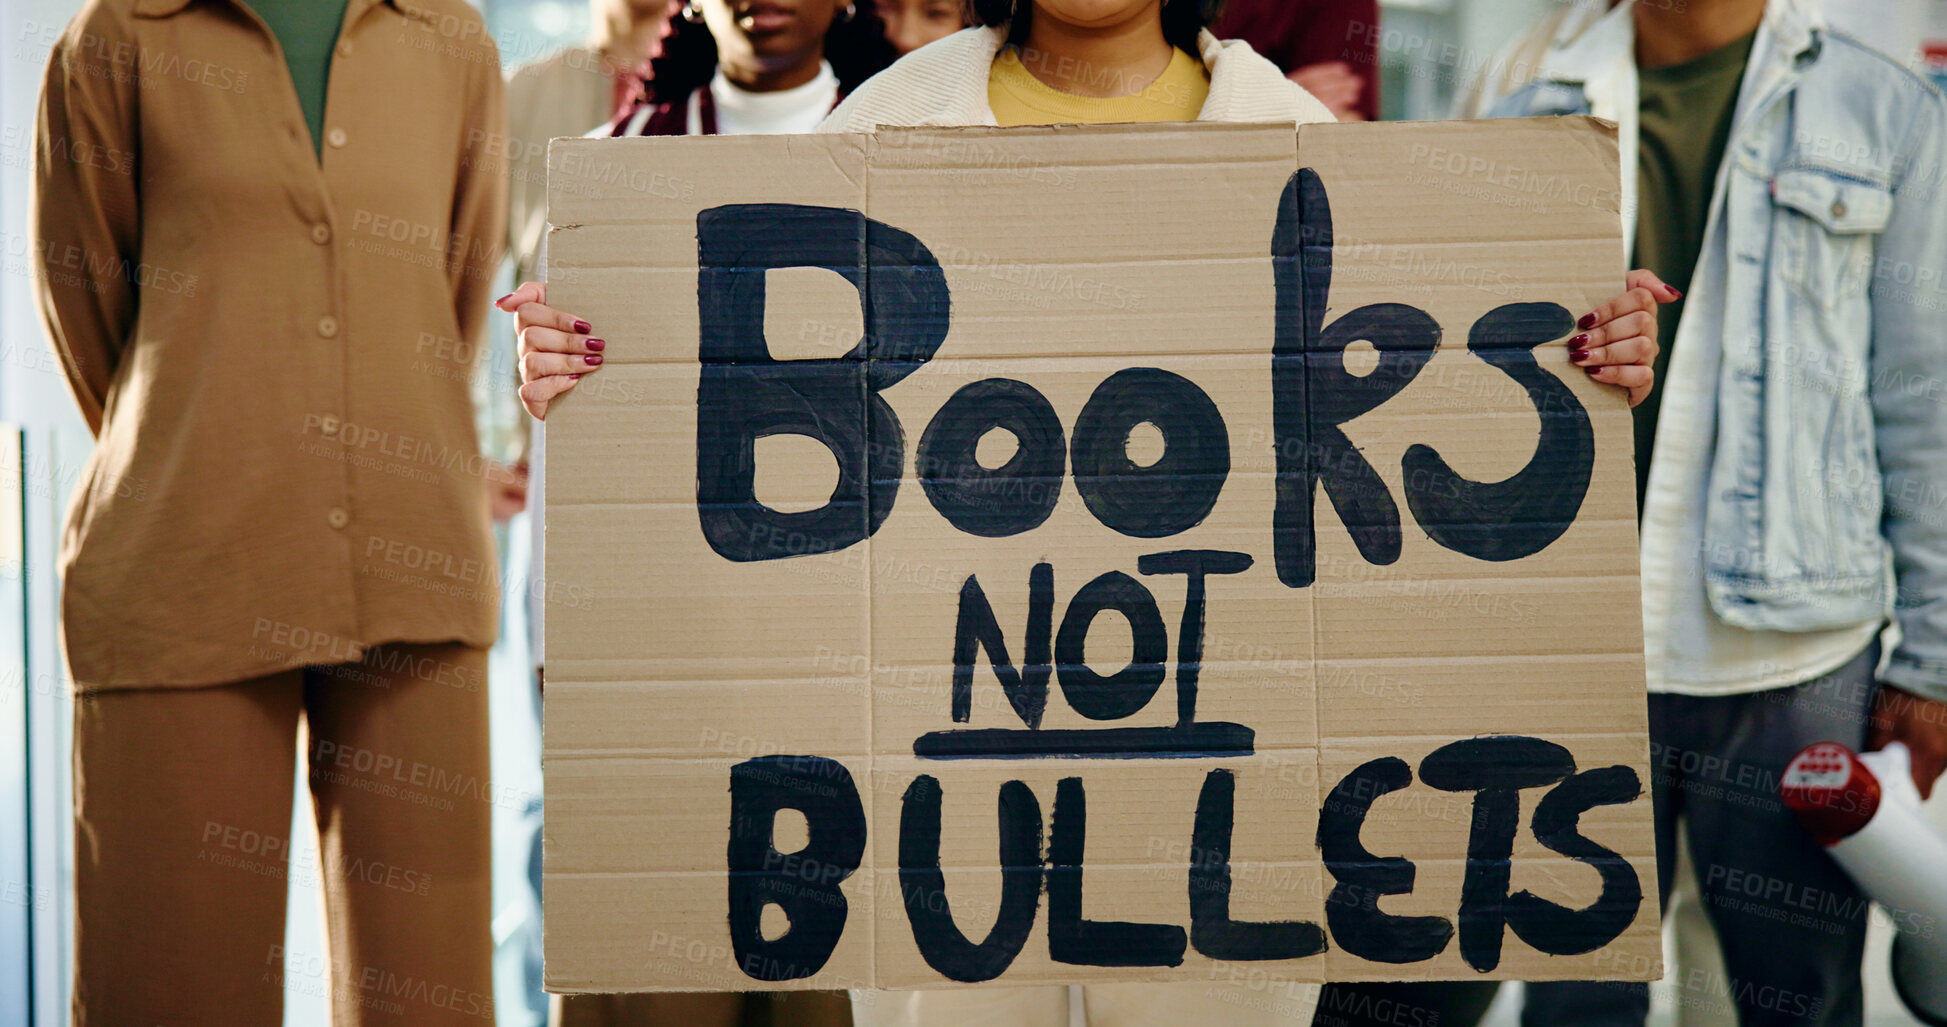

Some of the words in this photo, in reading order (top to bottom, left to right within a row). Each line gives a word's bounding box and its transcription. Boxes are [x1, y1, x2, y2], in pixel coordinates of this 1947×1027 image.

[696, 168, 1595, 588] Books
[951, 549, 1254, 729] NOT
[727, 735, 1644, 983] BULLETS
